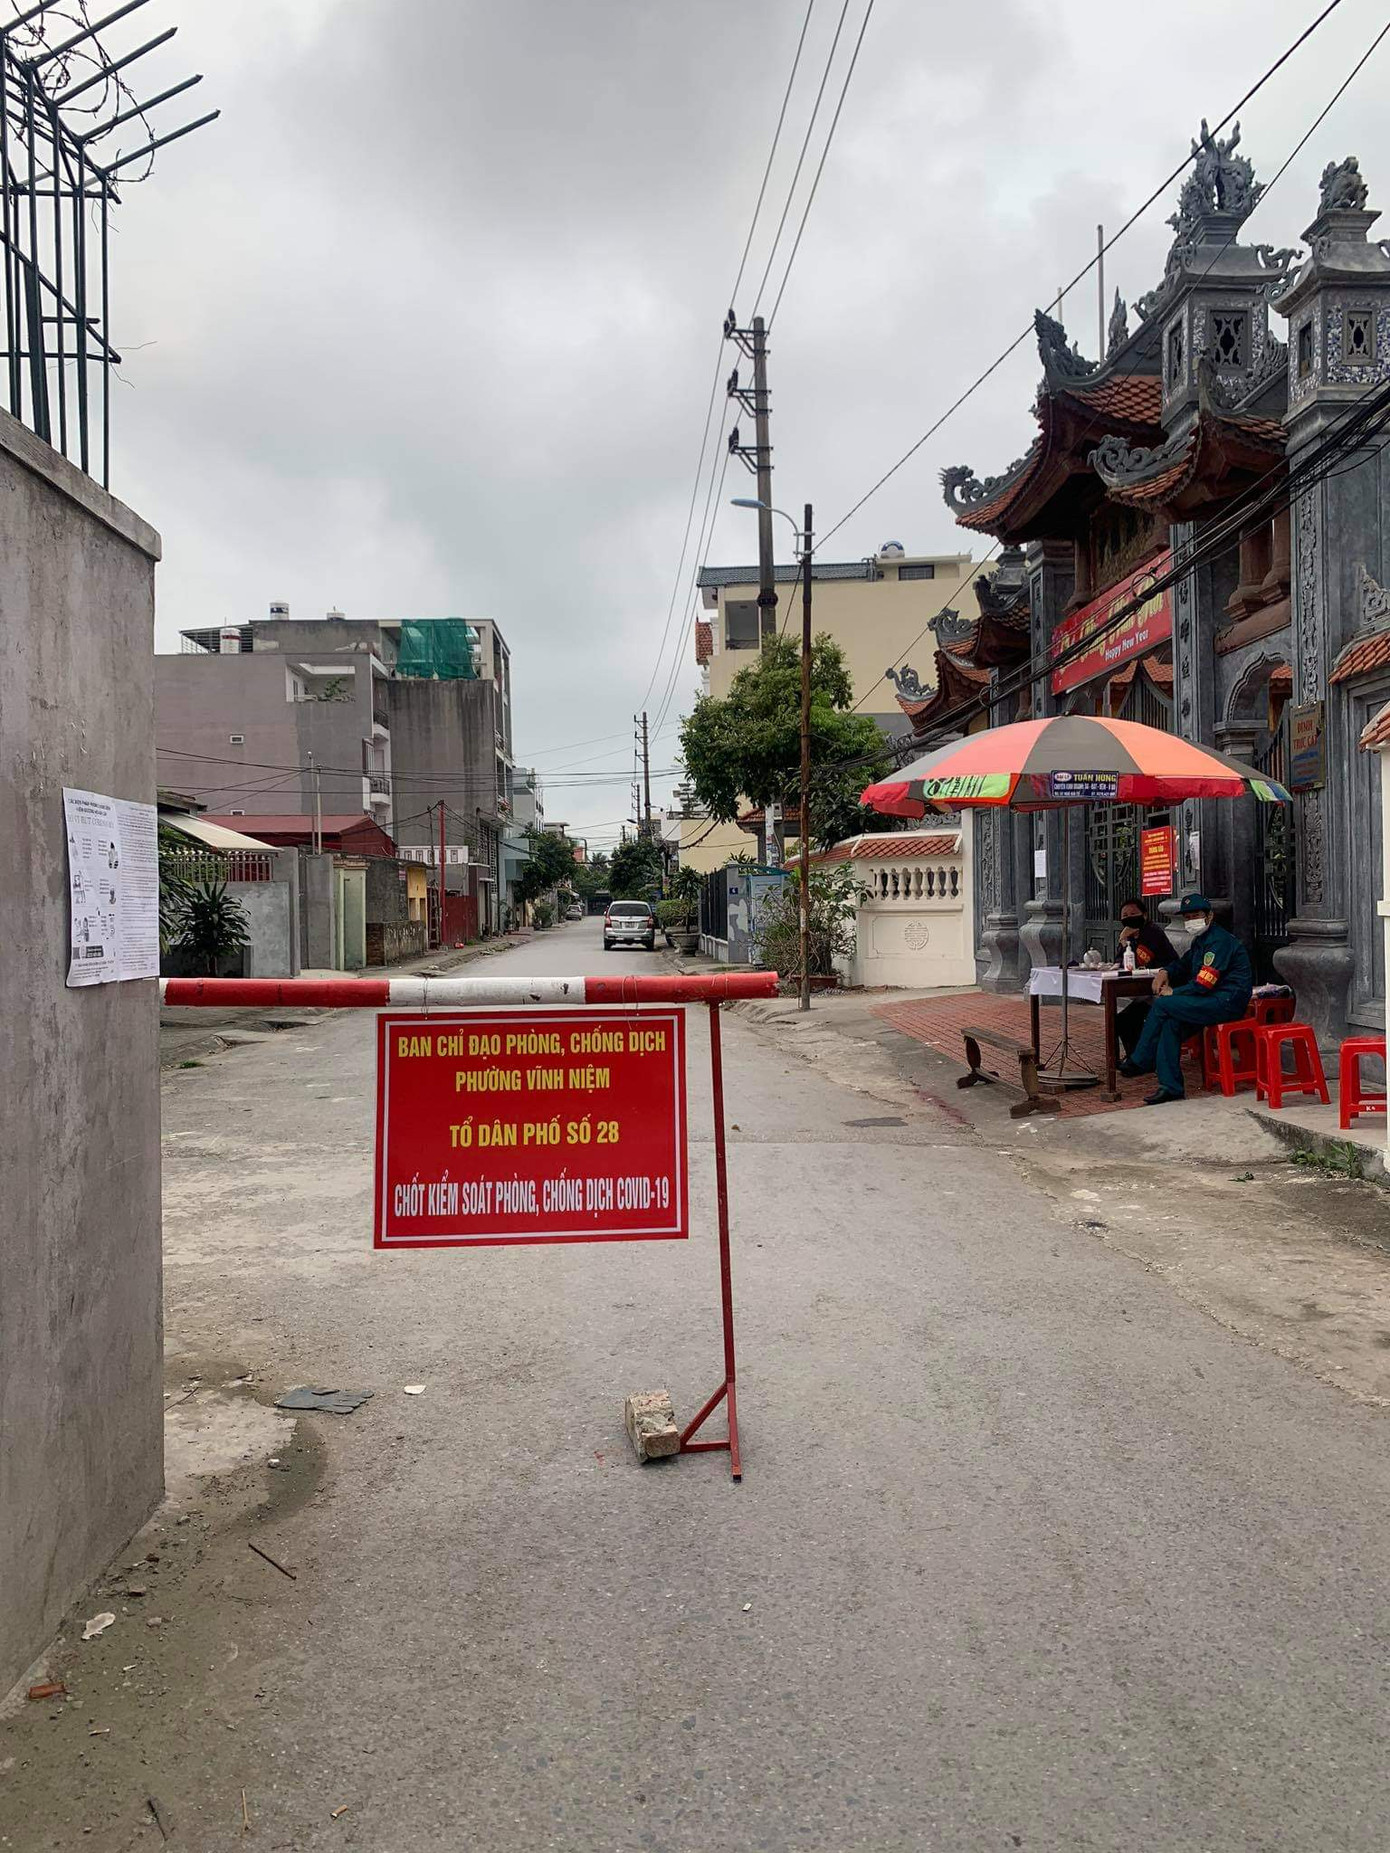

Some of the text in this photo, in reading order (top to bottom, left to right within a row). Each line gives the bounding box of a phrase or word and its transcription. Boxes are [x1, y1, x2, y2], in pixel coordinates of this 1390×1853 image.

[1105, 629, 1149, 662] Happy New Year
[398, 1024, 666, 1060] BAN CHỈ ĐẠO PHÒNG, CHỐNG DỊCH
[455, 1063, 610, 1094] PHƯỜNG VĨNH NIỆM
[450, 1113, 620, 1147] TỔ DÂN PHỐ SỐ 28
[394, 1167, 670, 1218] CHỐT KIỂM SOÁT PHÒNG, CHỐNG DỊCH COVID-19
